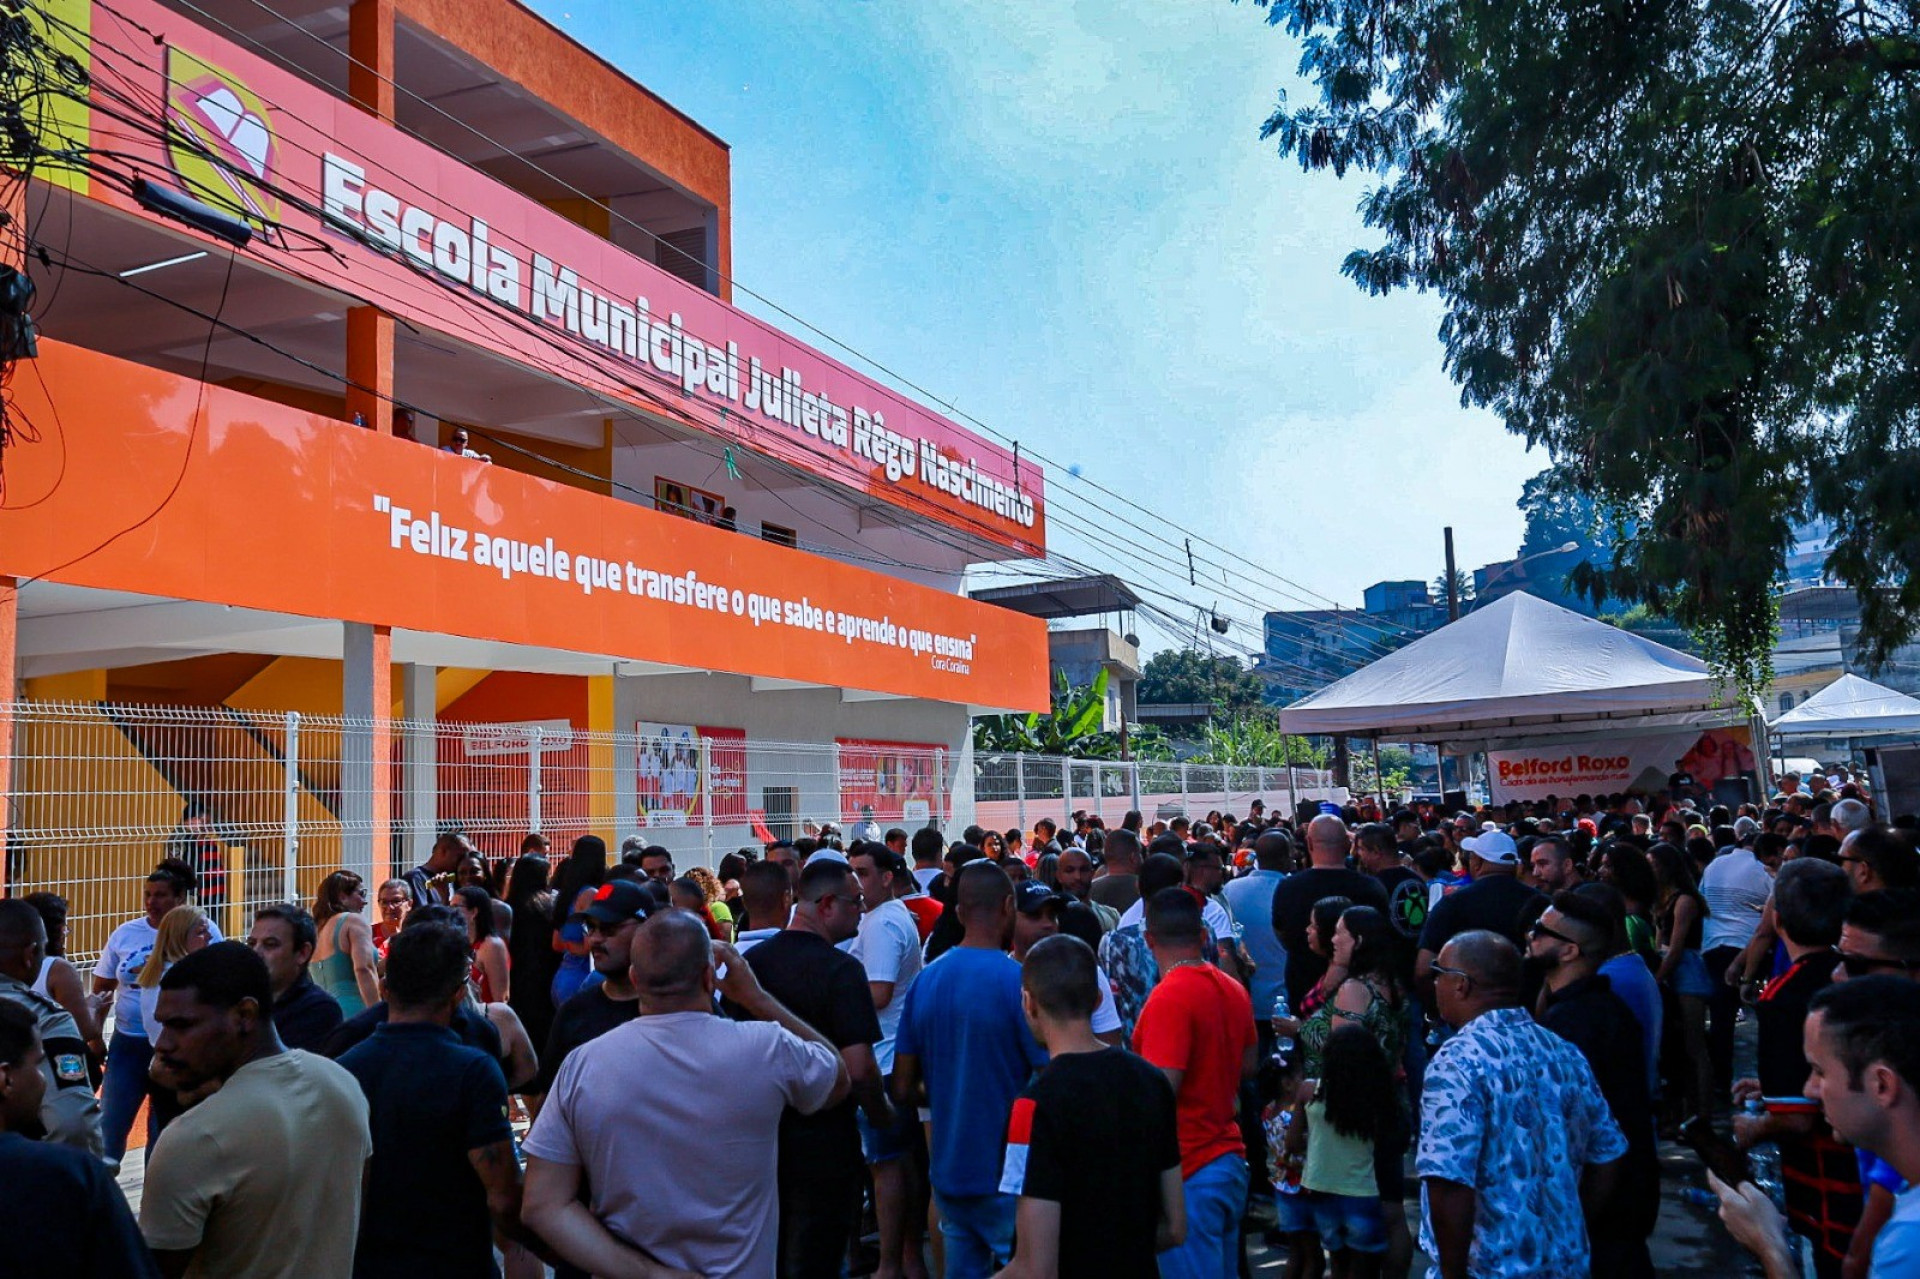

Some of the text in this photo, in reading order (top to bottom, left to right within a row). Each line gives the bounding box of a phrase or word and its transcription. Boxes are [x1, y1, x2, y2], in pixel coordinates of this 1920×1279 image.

[323, 152, 1034, 528] Escola Municipal Julieta Rêgo Nascimento
[473, 532, 570, 580] aquele
[575, 555, 622, 595] que
[626, 561, 728, 613] transfere
[732, 590, 744, 616] o
[748, 593, 780, 627] que
[784, 597, 823, 631] sabe
[825, 610, 835, 634] e
[837, 612, 895, 645] aprende
[899, 627, 907, 649] o
[909, 629, 933, 657] que
[931, 655, 970, 675] Cora Coralina
[533, 737, 567, 747] OXO
[1498, 755, 1630, 777] Belford Roxo
[1500, 777, 1523, 787] Cada
